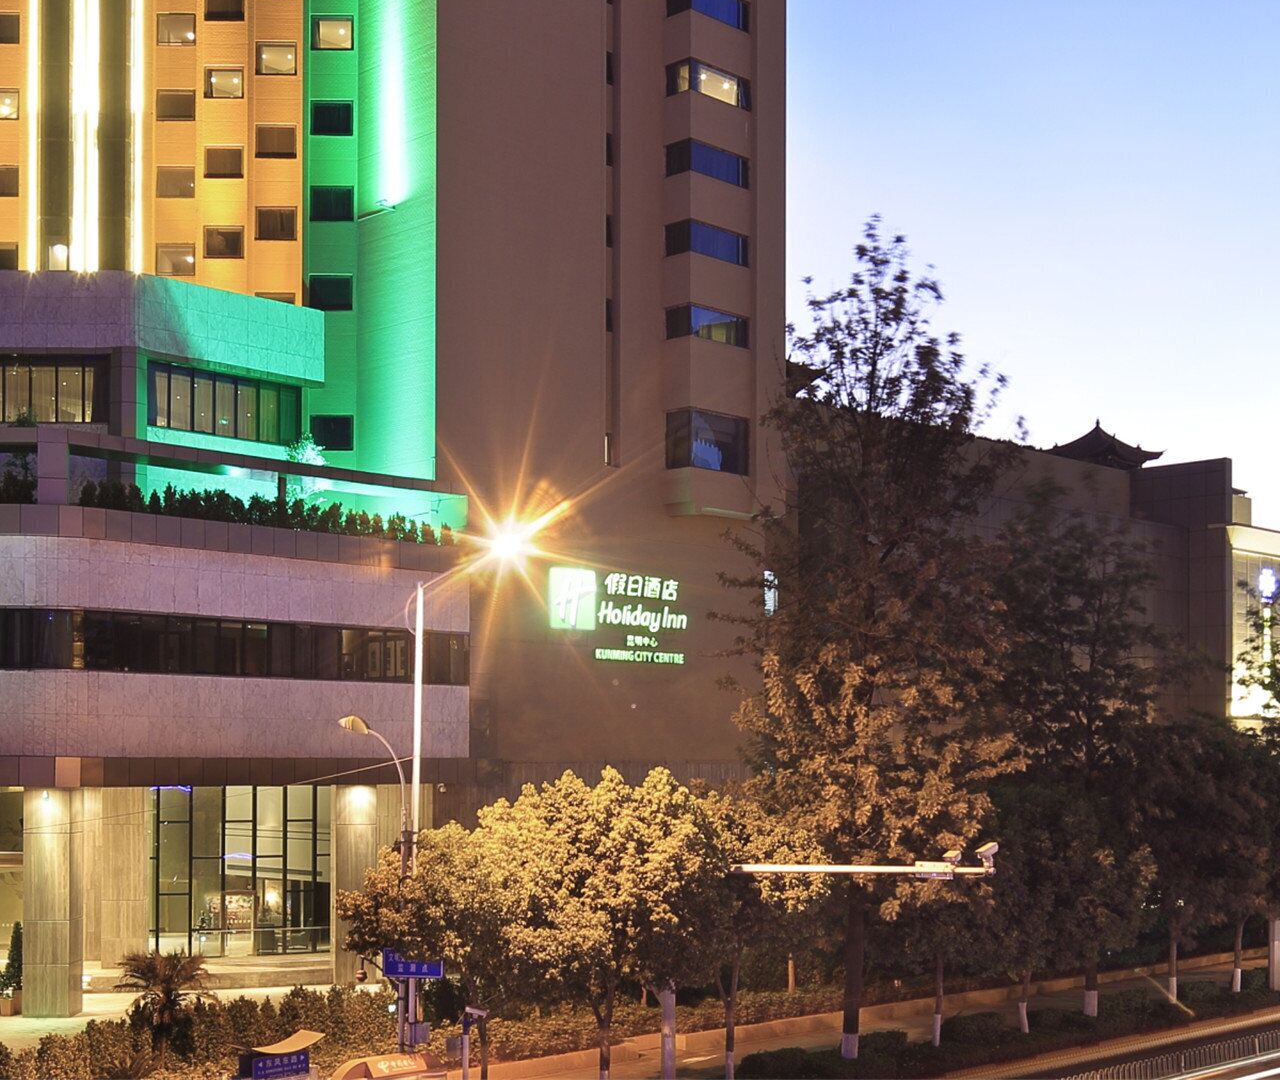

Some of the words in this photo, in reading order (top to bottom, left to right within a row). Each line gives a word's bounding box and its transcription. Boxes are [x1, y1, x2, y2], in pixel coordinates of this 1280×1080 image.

[604, 572, 679, 602] 假日酒店
[597, 600, 661, 633] Holiday
[662, 605, 688, 630] Inn
[626, 634, 659, 648] 昆明中心
[595, 647, 634, 662] KUNMING
[634, 650, 653, 663] CITY
[653, 652, 685, 665] CENTRE
